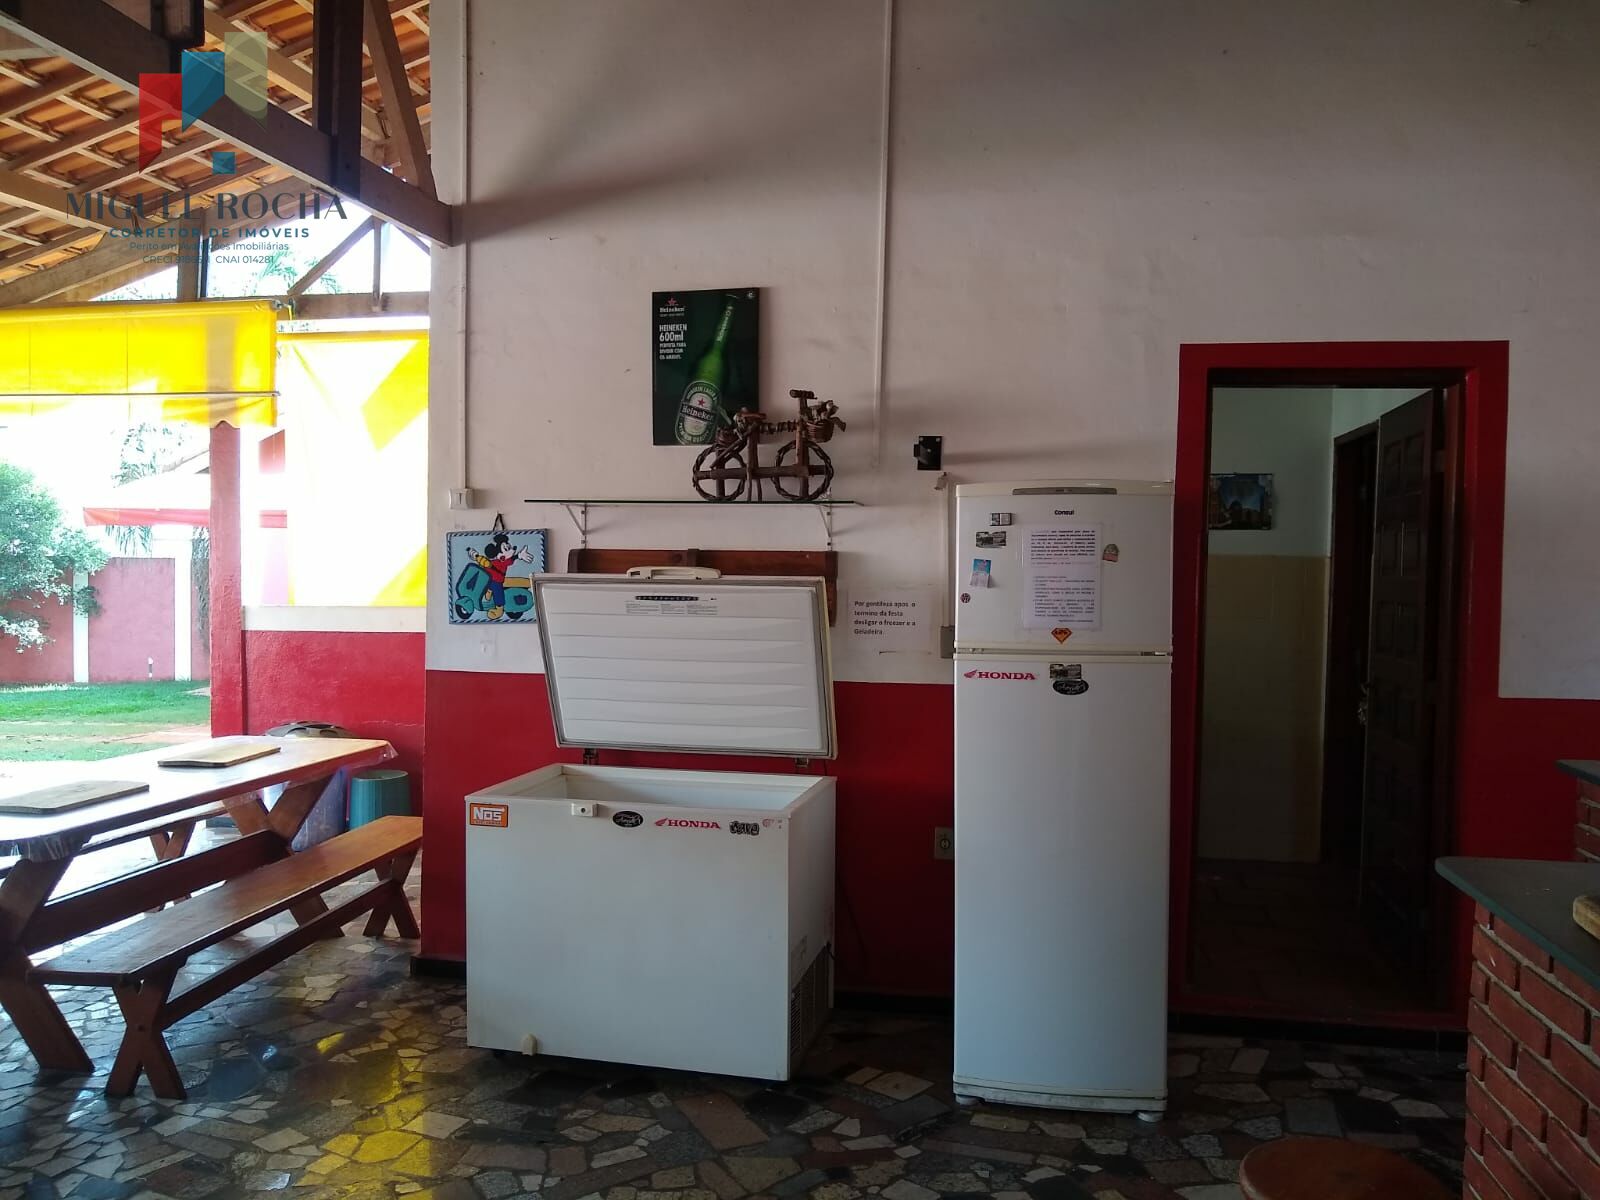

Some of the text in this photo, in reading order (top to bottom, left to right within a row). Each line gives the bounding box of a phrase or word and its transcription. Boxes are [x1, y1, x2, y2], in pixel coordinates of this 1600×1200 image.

[659, 323, 688, 332] HEINEKEN
[659, 331, 684, 342] 600ml
[884, 618, 905, 626] freezer
[978, 671, 1036, 680] HONDA
[473, 806, 504, 821] NOS
[668, 819, 721, 830] HONDA
